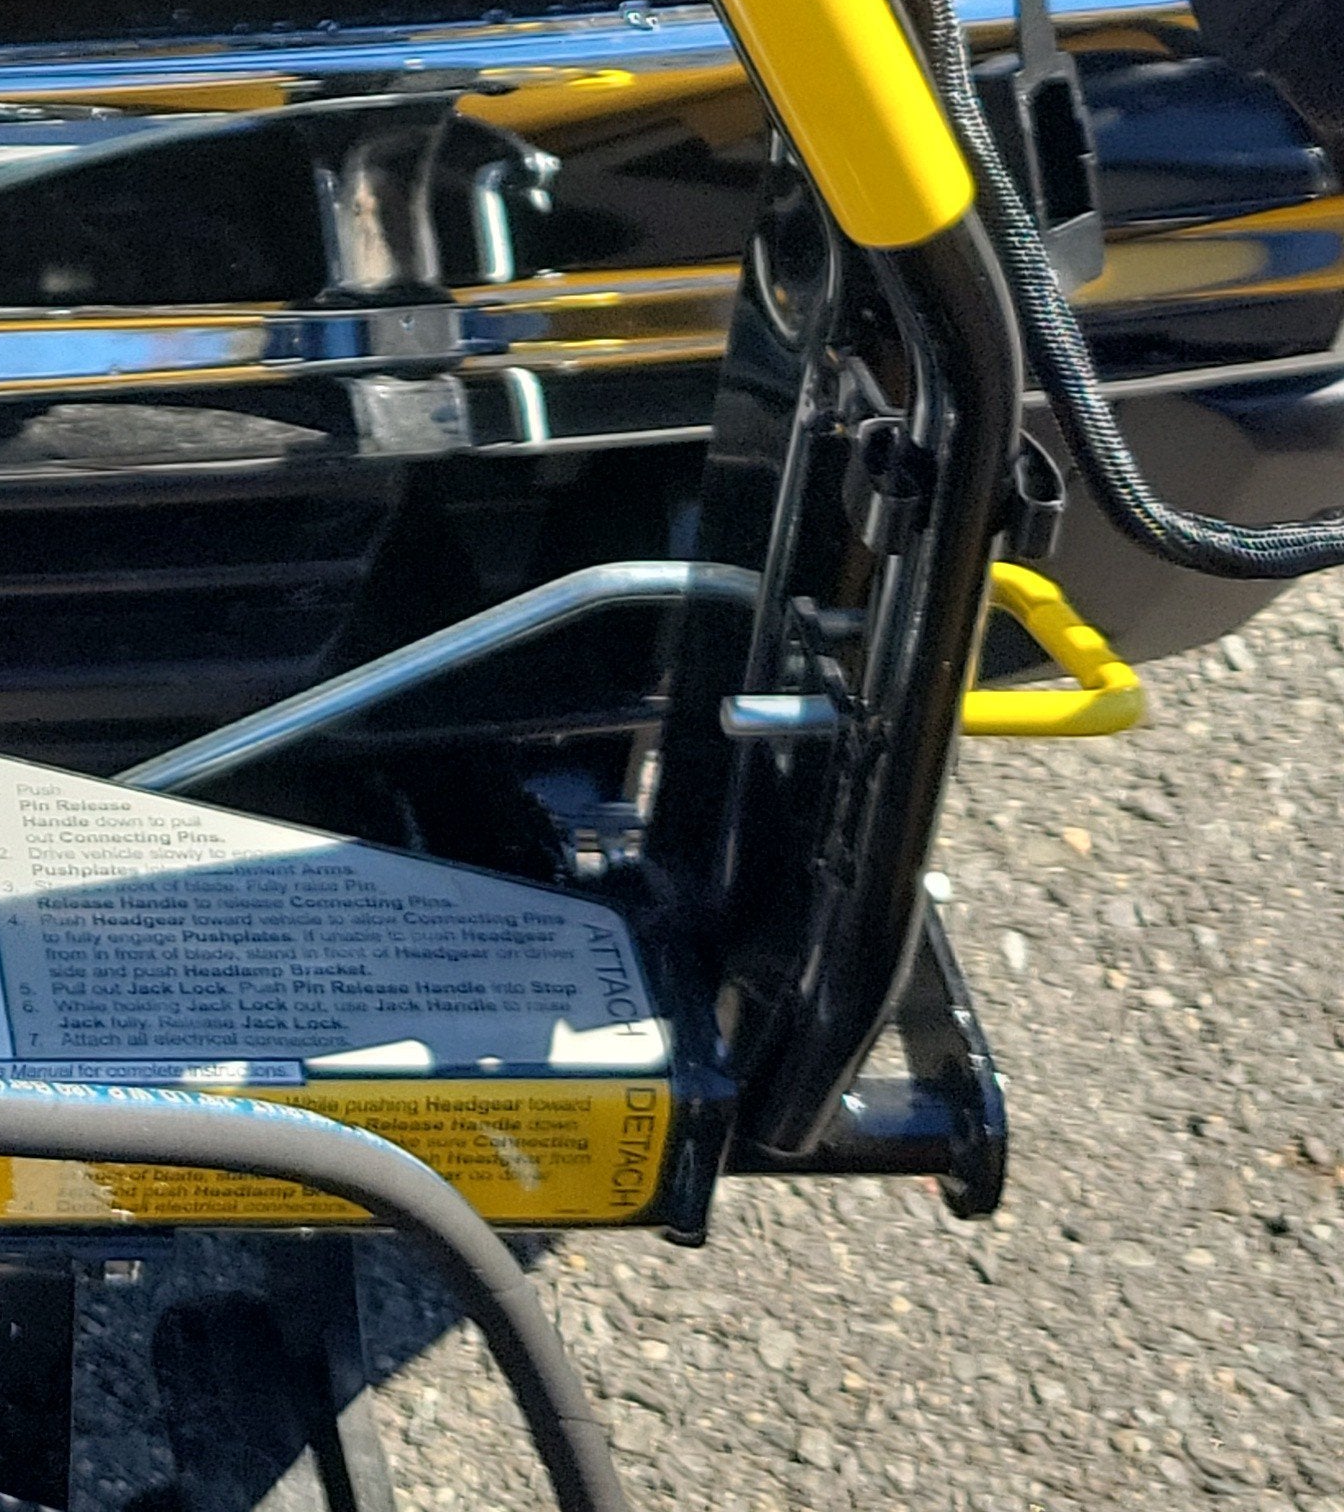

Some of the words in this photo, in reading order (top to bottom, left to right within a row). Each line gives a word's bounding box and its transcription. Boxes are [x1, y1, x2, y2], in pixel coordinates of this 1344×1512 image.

[17, 784, 61, 796] Push
[18, 799, 50, 811] Pin
[56, 799, 132, 811] Release
[22, 815, 90, 827] Handle
[95, 815, 144, 827] down
[25, 831, 55, 843] out
[59, 831, 172, 846] Connecting
[178, 831, 226, 843] Pins.
[29, 848, 75, 859] Drive
[81, 848, 143, 859] vehicle
[151, 848, 204, 862] slowly
[37, 896, 114, 909] Release
[120, 896, 188, 909] Handle
[289, 896, 403, 910] Connecting
[40, 914, 87, 926] Push
[92, 914, 185, 929] Headgear
[192, 914, 252, 926] toward
[403, 912, 517, 927] Connecting
[66, 931, 101, 946] fully
[45, 948, 87, 960] from
[394, 948, 489, 963] Headgear
[48, 965, 86, 978] side
[93, 965, 127, 978] and
[133, 965, 178, 981] push
[184, 965, 283, 981] Headlamp
[581, 923, 648, 1037] ATTACH
[127, 982, 174, 995] Jack
[179, 982, 233, 995] Lock.
[293, 982, 325, 995] Pin
[331, 982, 410, 995] Release
[415, 982, 487, 995] Handle
[186, 999, 233, 1011] Jack
[238, 999, 289, 1011] Lock
[374, 999, 421, 1011] Jack
[426, 999, 498, 1011] Handle
[59, 1016, 106, 1029] Jack
[242, 1016, 290, 1029] Jack
[61, 1034, 121, 1046] Attach
[153, 1034, 237, 1046] electrical
[10, 1064, 73, 1078] Manual
[78, 1064, 99, 1078] for
[105, 1064, 182, 1081] complete
[345, 1096, 419, 1114] pushing
[426, 1096, 521, 1114] Headgear
[529, 1096, 592, 1111] toward
[610, 1087, 657, 1207] DETACH
